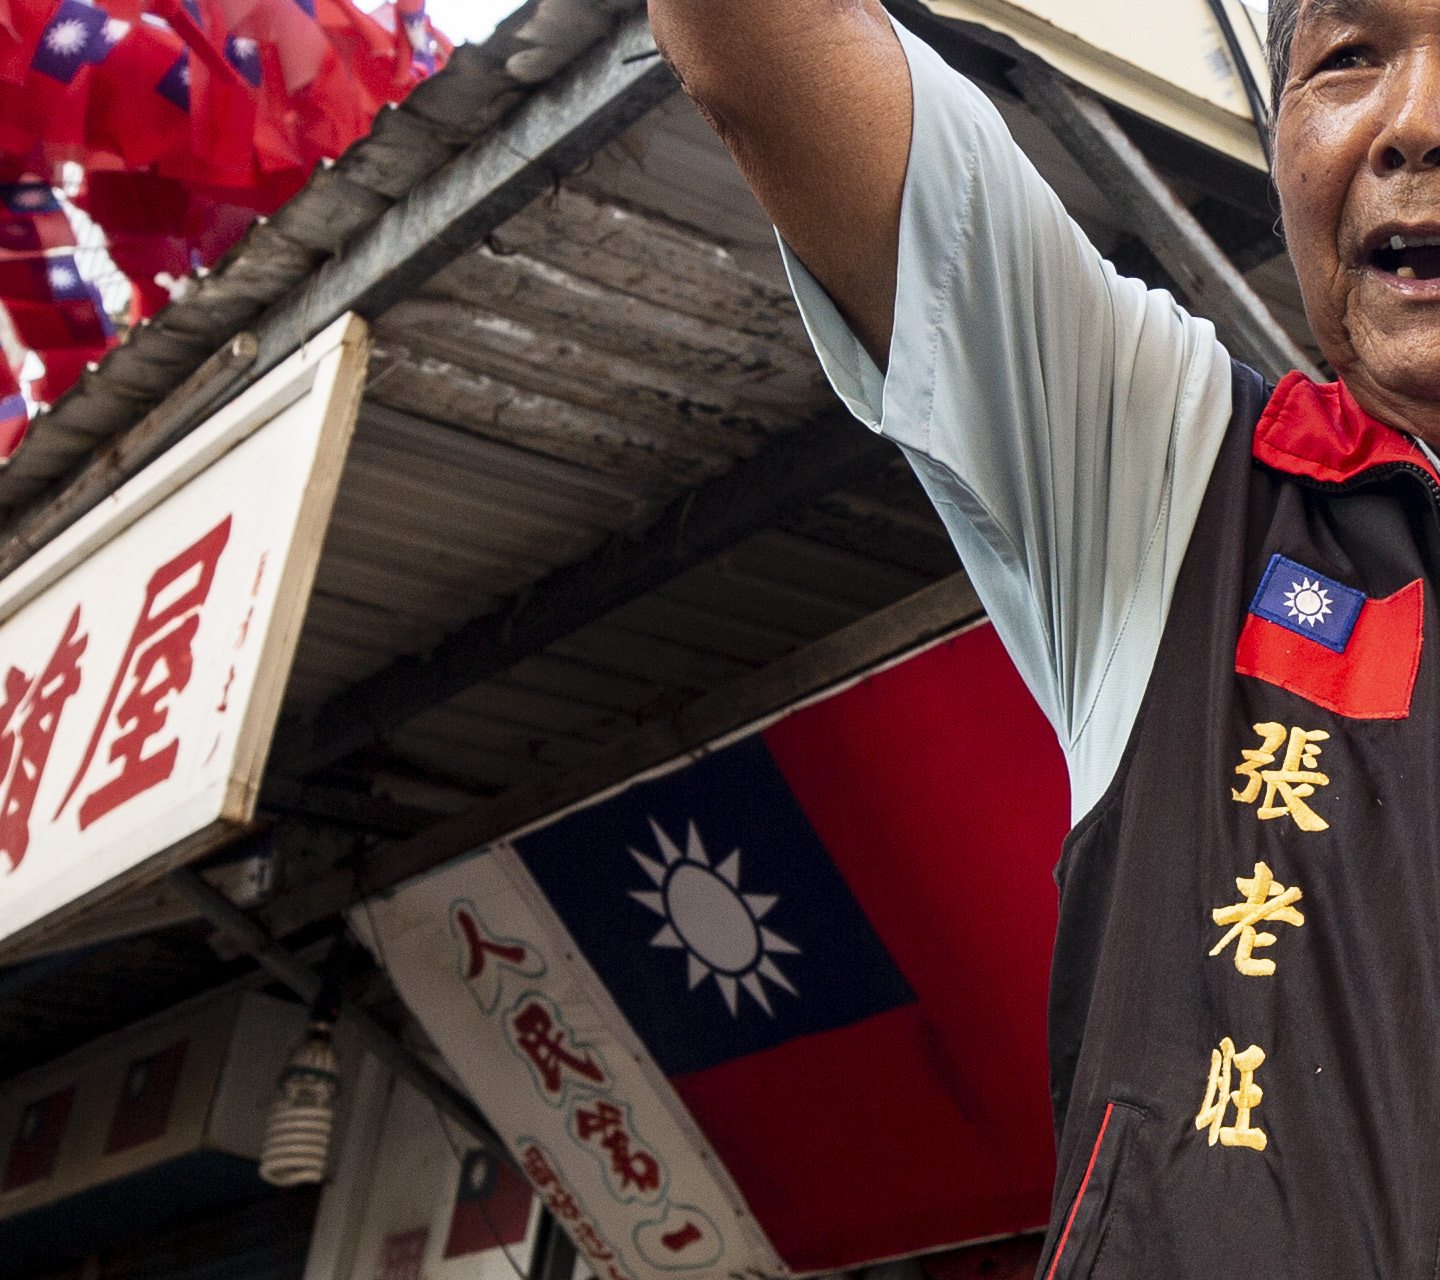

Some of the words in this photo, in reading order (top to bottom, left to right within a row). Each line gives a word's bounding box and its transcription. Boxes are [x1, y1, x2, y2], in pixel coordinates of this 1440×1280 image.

[457, 911, 705, 1252] 人民第一
[1195, 721, 1331, 1152] 張老旺
